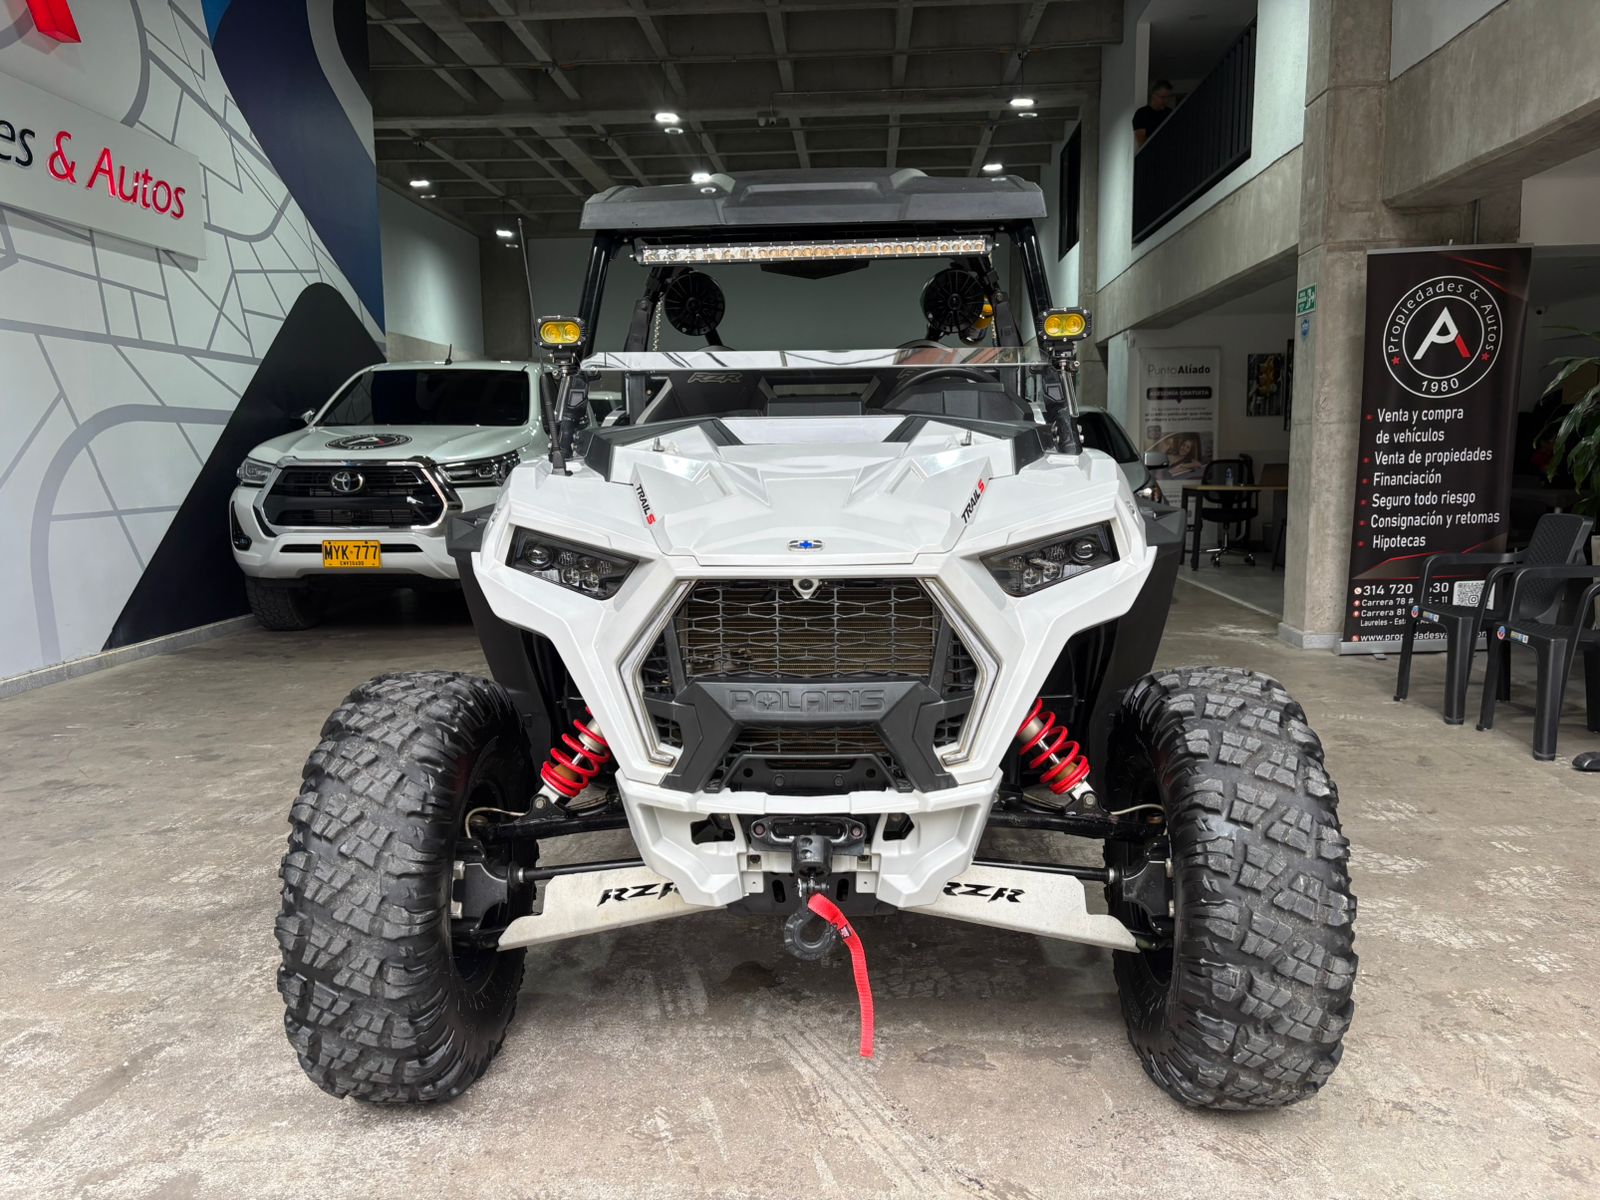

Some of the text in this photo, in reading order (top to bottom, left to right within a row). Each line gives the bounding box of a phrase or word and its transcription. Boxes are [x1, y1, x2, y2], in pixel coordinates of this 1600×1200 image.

[48, 131, 76, 184] &
[86, 147, 186, 219] Autos
[1388, 281, 1498, 353] Propiedades & Autos
[1421, 378, 1459, 393] 1980
[1377, 408, 1464, 425] Venta y compra
[1376, 426, 1445, 444] de vehículos
[1375, 447, 1493, 466] Venta de propiedades
[1373, 468, 1442, 486] Financiación
[1372, 490, 1476, 510] Seguro todo riesgo
[1370, 510, 1500, 530] Consignación y retomas
[1372, 534, 1426, 551] Hipotecas
[324, 545, 378, 560] MYK 777
[1363, 585, 1385, 596] 314
[1389, 584, 1413, 595] 720
[1361, 599, 1394, 607] Carrera
[1395, 598, 1406, 606] 78
[1361, 608, 1406, 617] Carrera 81
[1360, 618, 1388, 627] Laureles
[729, 690, 886, 712] POLARIS
